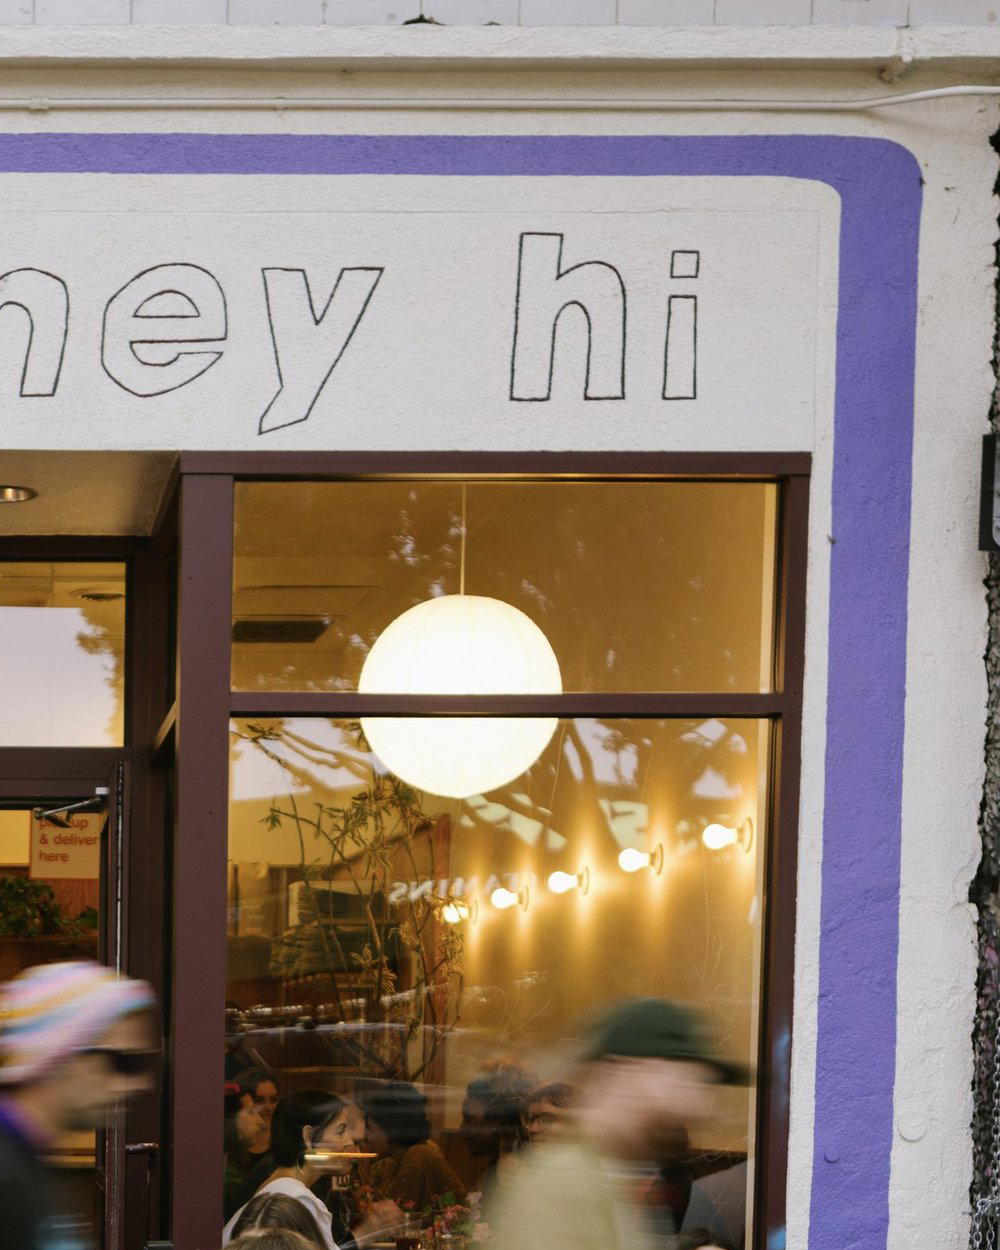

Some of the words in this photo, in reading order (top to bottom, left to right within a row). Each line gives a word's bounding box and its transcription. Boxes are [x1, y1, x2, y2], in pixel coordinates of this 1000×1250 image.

[508, 230, 701, 403] hi
[39, 832, 49, 845] &
[39, 851, 69, 862] here
